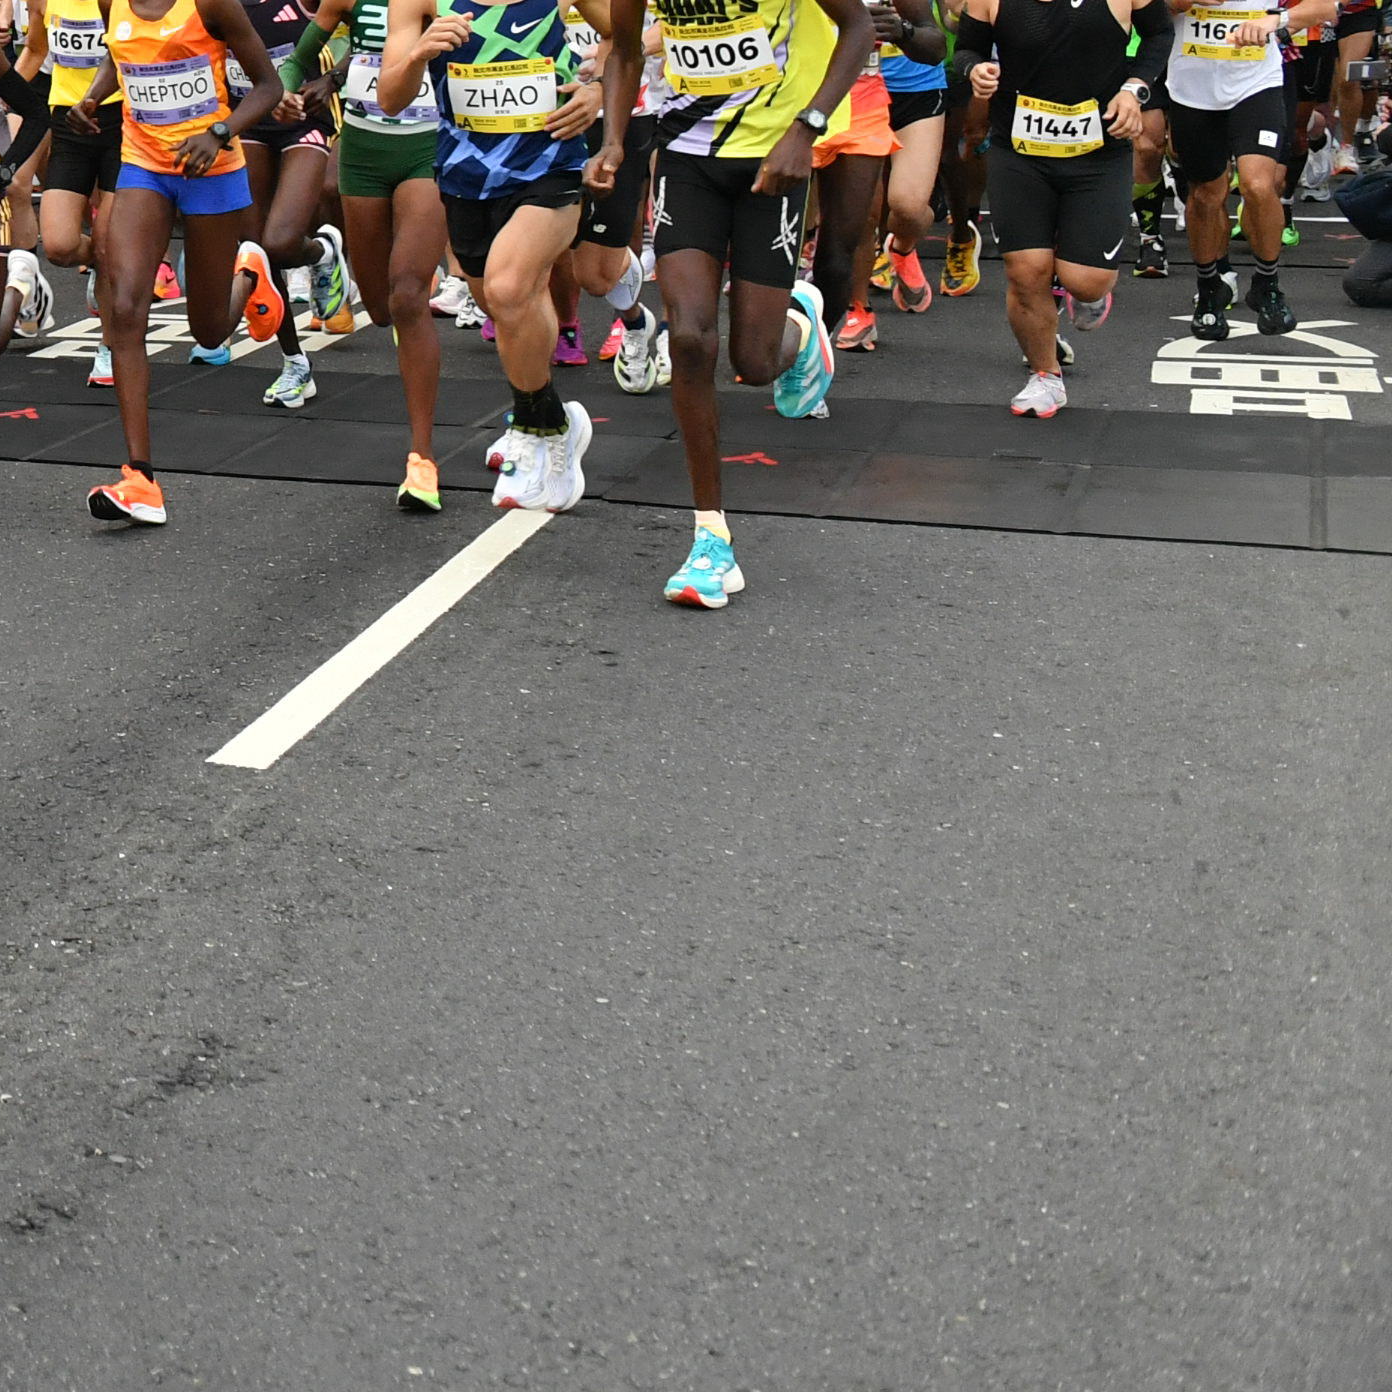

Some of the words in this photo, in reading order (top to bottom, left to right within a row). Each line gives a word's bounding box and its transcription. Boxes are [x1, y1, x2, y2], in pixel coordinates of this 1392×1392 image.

[671, 37, 759, 69] 10106
[1187, 45, 1197, 55] A
[128, 77, 208, 103] CHEPTOO
[464, 85, 538, 108] ZHAO
[680, 78, 689, 92] A
[1023, 114, 1092, 137] 11447
[1016, 141, 1027, 152] A
